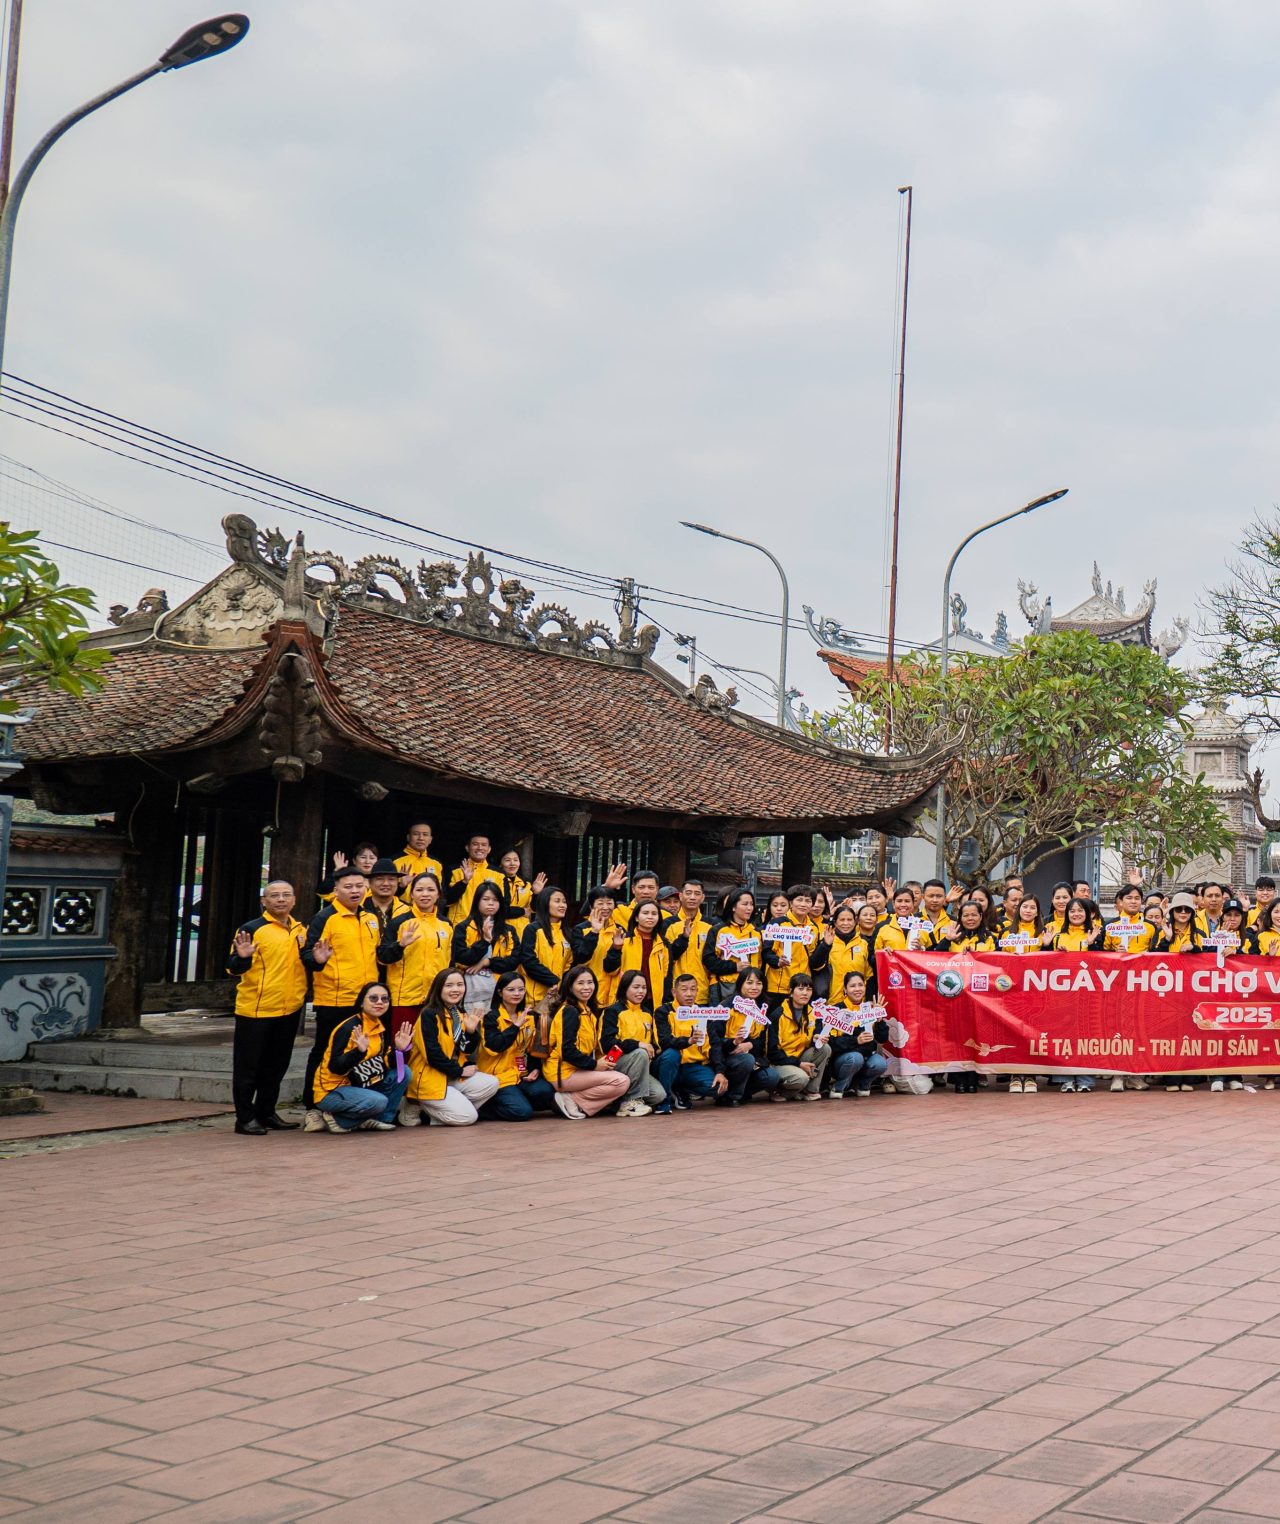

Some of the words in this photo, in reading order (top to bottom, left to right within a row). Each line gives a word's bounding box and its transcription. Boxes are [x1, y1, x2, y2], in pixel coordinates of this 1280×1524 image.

[1023, 961, 1119, 992] NGÀY
[1127, 962, 1183, 997] HỘI
[1191, 968, 1258, 998] CHỢ
[1215, 1006, 1272, 1024] 2025
[1030, 1032, 1049, 1056] LỄ
[1053, 1039, 1073, 1060] TẠ
[1078, 1032, 1134, 1056] NGUỒN
[1150, 1039, 1176, 1056] TRI
[1180, 1035, 1202, 1056] ÂN
[1207, 1040, 1223, 1056] DI
[1228, 1034, 1259, 1056] SẢN
